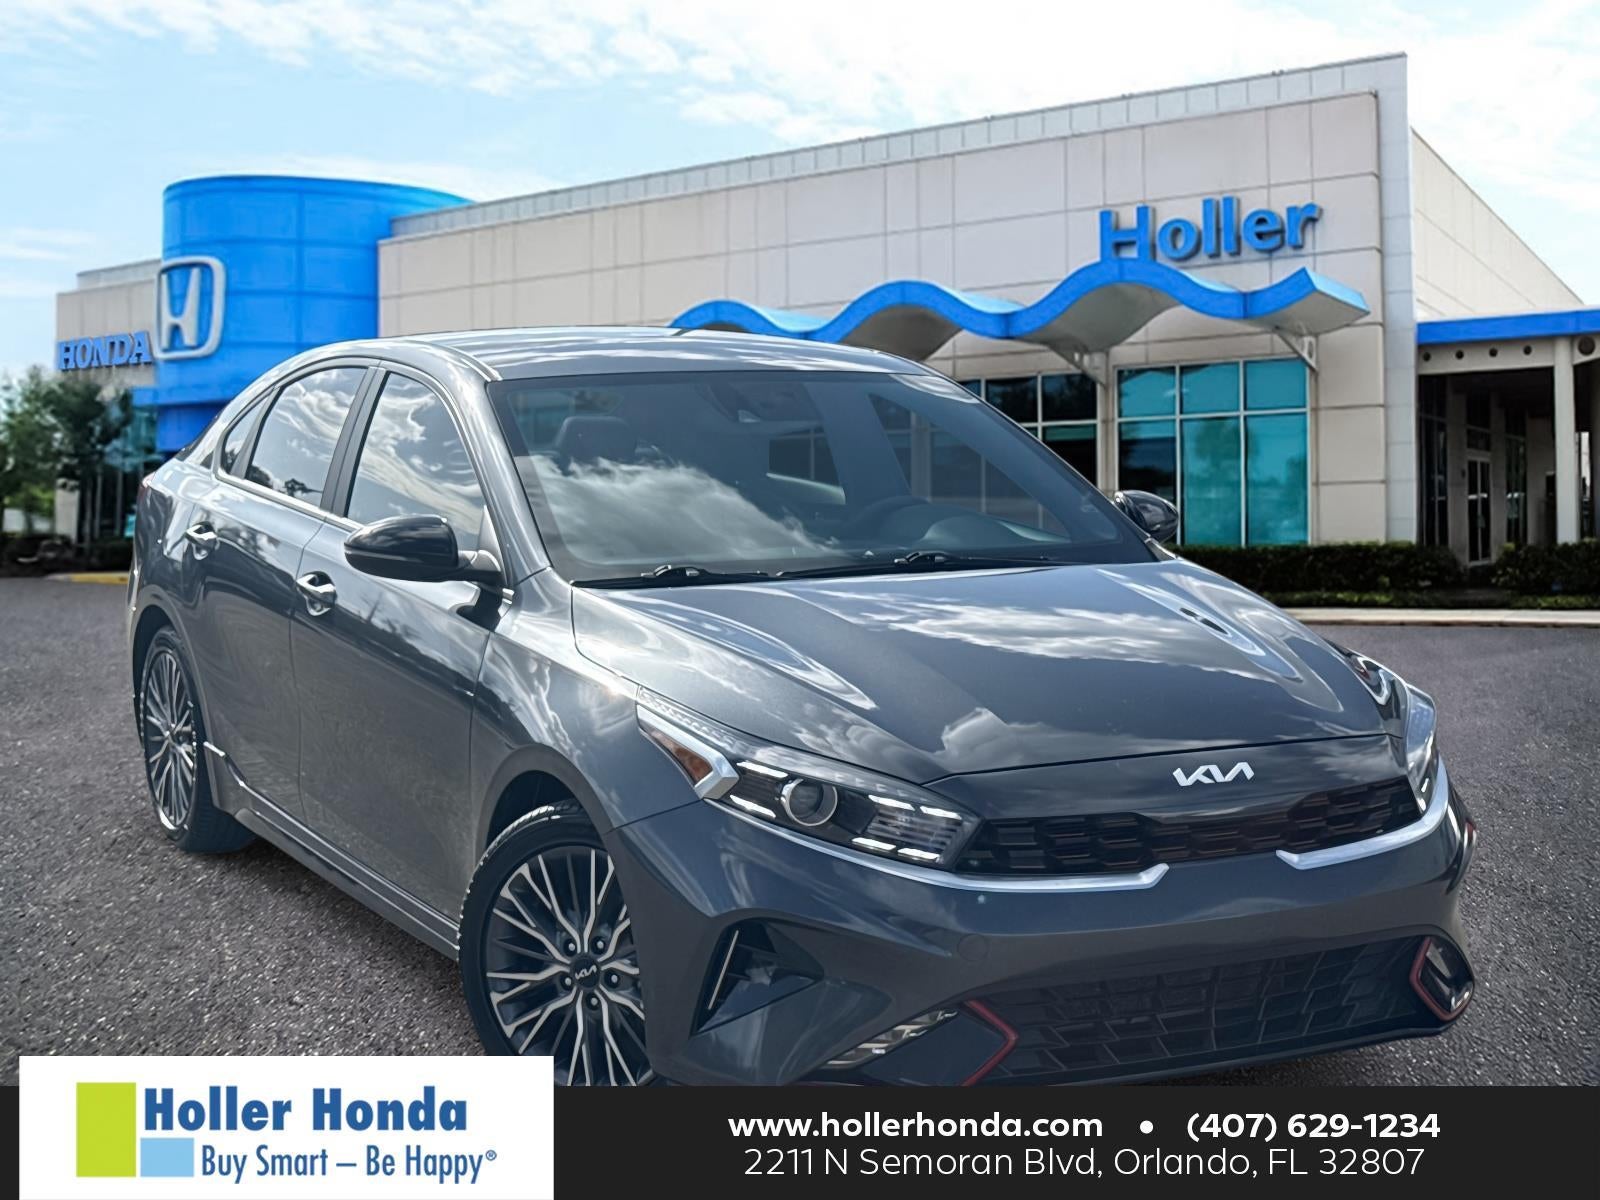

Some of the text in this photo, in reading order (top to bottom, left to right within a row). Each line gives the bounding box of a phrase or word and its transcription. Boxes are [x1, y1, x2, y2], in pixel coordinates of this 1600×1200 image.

[1098, 196, 1322, 260] Holler
[58, 331, 152, 370] HONDA
[1172, 761, 1255, 787] KIA
